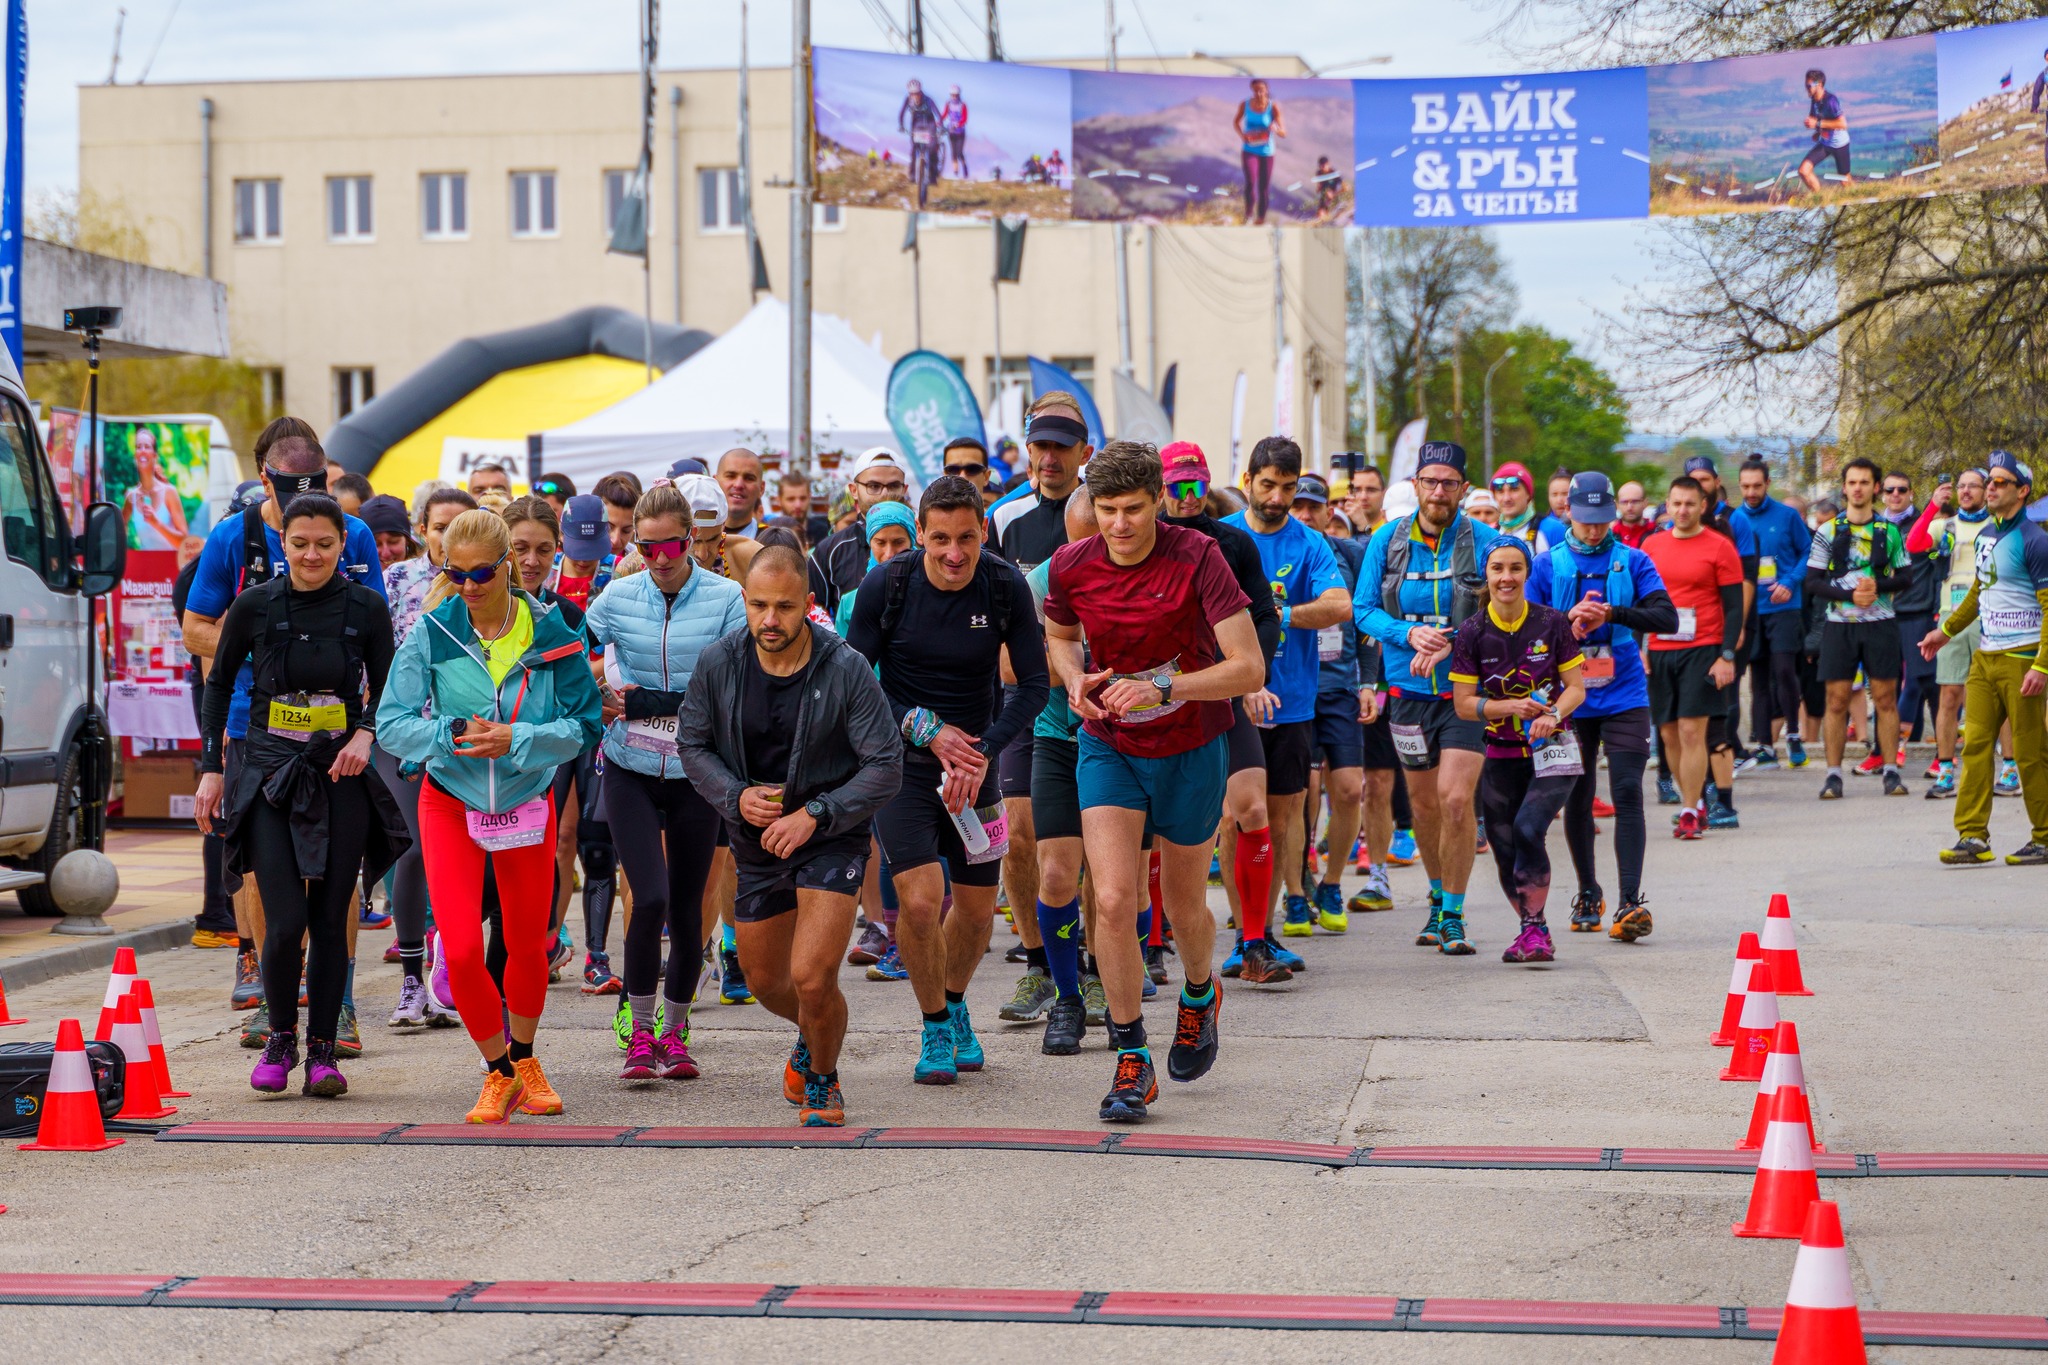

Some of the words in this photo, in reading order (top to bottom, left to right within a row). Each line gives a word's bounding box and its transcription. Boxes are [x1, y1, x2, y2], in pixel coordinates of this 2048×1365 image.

[1411, 80, 1577, 134] БАЙК
[1412, 150, 1450, 190] &
[1456, 146, 1578, 189] РЪН
[1413, 193, 1456, 217] ЗА
[1461, 190, 1578, 216] ЧЕПЪН
[1425, 444, 1449, 461] Buff
[121, 578, 173, 600] Магнезий
[149, 687, 183, 697] Protefix
[281, 709, 311, 724] 1234
[642, 717, 676, 733] 9016
[1542, 750, 1567, 761] 9025
[481, 811, 519, 828] 4406
